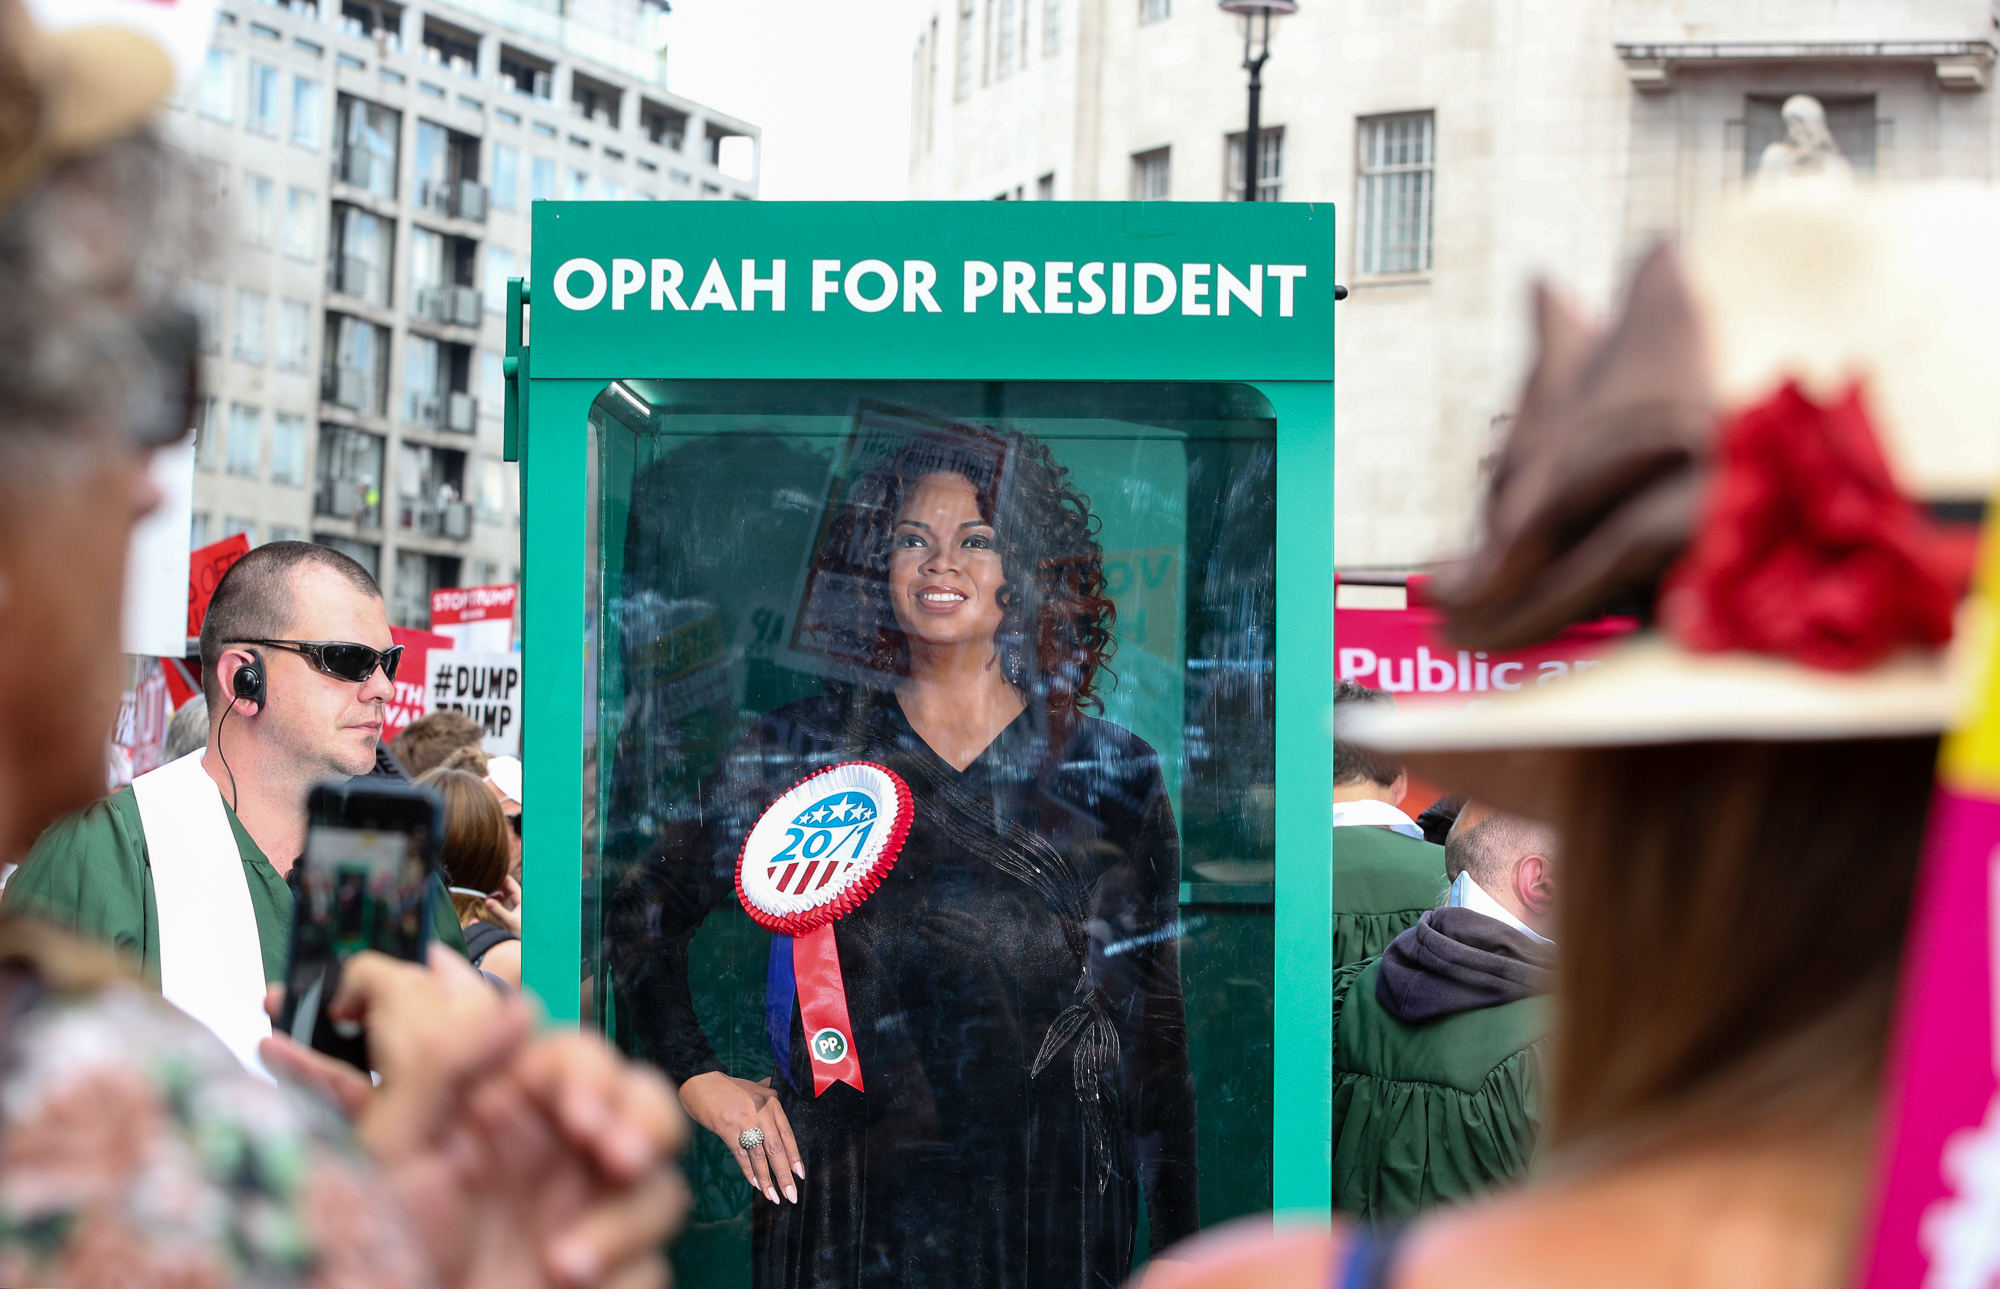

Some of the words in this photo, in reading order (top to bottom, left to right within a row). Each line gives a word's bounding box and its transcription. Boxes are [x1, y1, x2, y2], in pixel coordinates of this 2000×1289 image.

[553, 257, 787, 312] OPRAH
[811, 258, 943, 313] FOR
[963, 260, 1307, 318] PRESIDENT
[468, 588, 516, 607] TRUMP
[434, 664, 518, 700] #DUMP
[1339, 646, 1525, 693] Public
[436, 703, 511, 738] UMP
[770, 821, 875, 863] 20/1
